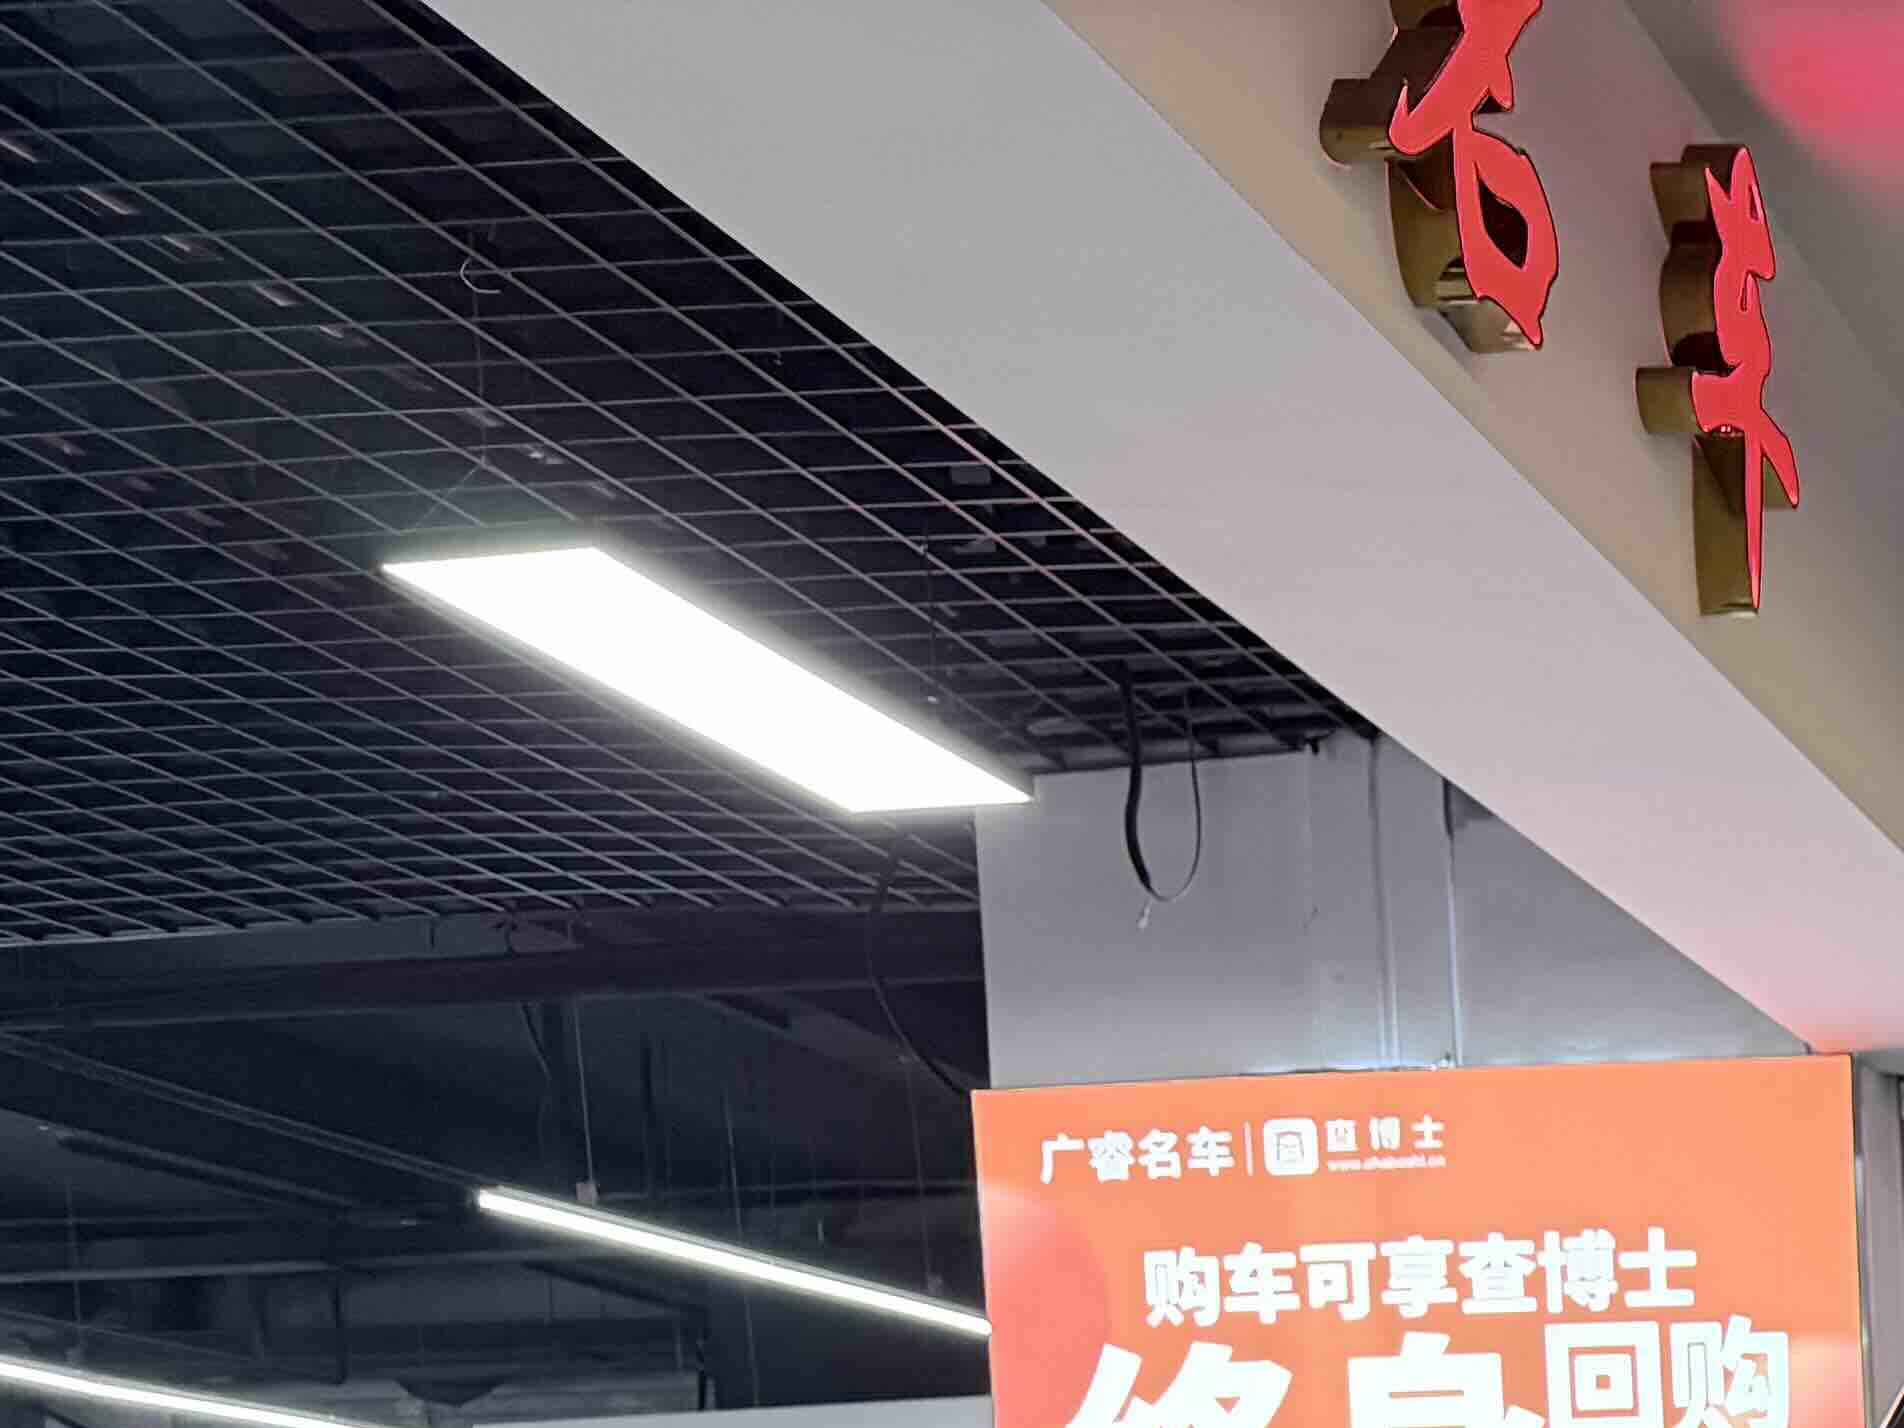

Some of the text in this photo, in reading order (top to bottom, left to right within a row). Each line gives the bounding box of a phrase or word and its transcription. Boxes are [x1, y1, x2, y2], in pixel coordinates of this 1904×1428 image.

[1040, 1127, 1235, 1184] 广睿名车
[1143, 1228, 1697, 1327] 购车可享查博士
